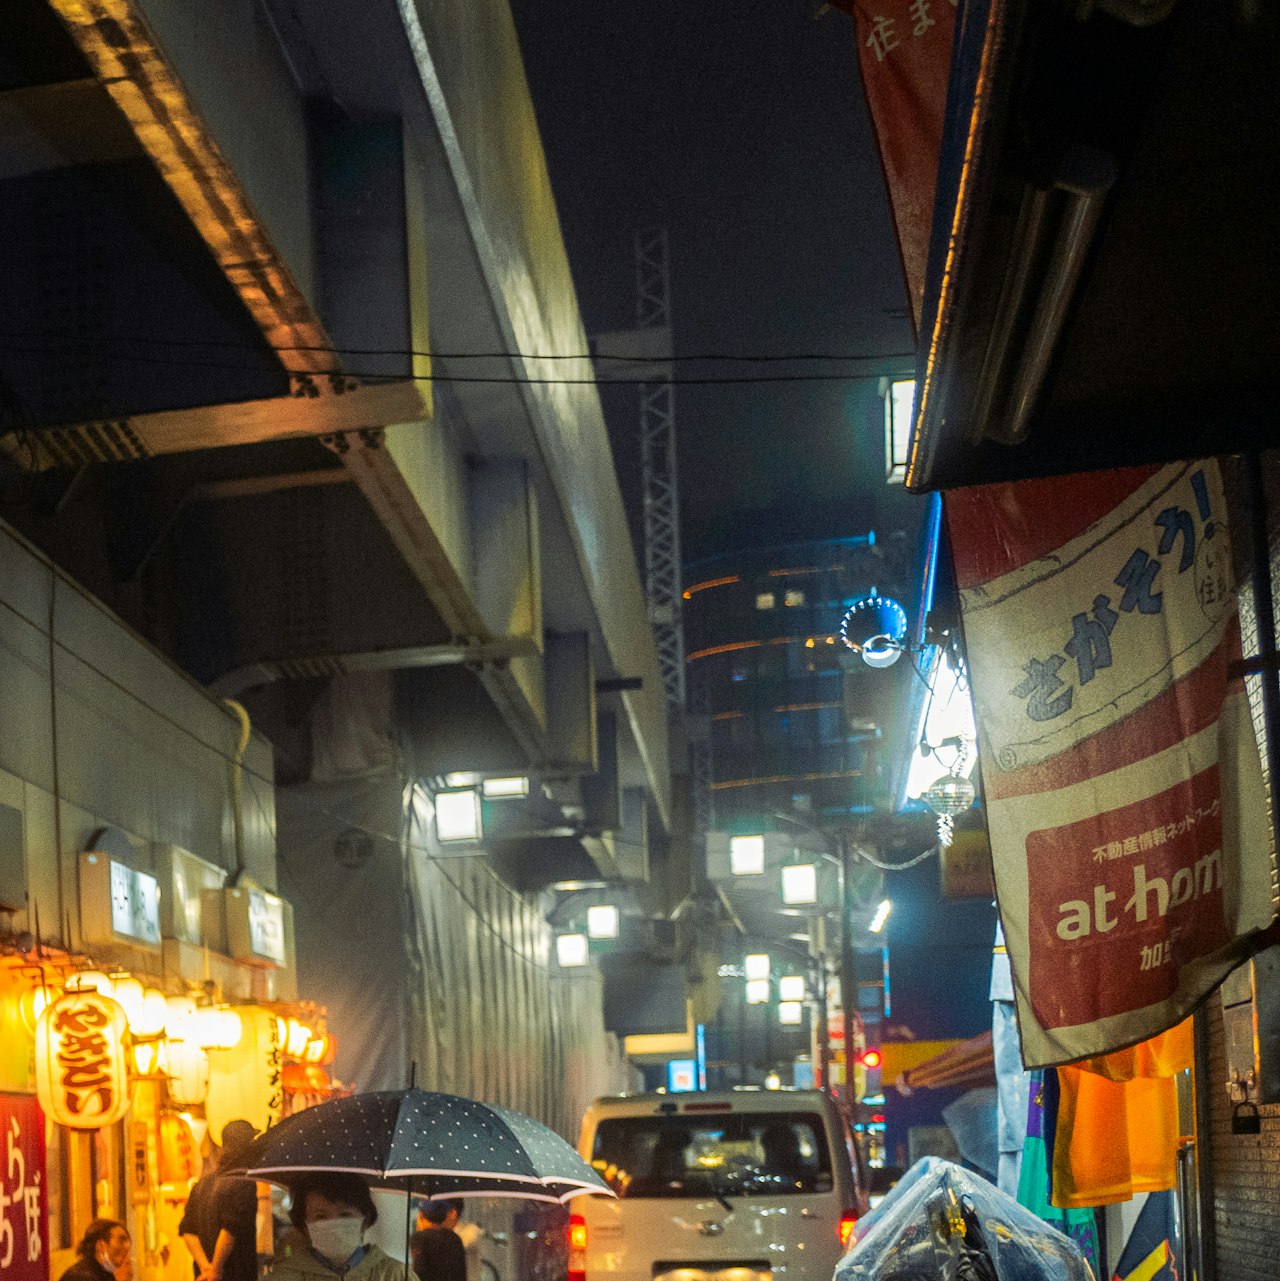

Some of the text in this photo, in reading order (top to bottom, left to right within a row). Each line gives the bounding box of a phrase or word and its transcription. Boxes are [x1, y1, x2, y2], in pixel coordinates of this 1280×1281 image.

[1009, 470, 1215, 723] さがそう!
[1055, 848, 1224, 942] at hom
[55, 1004, 111, 1114] やきとり
